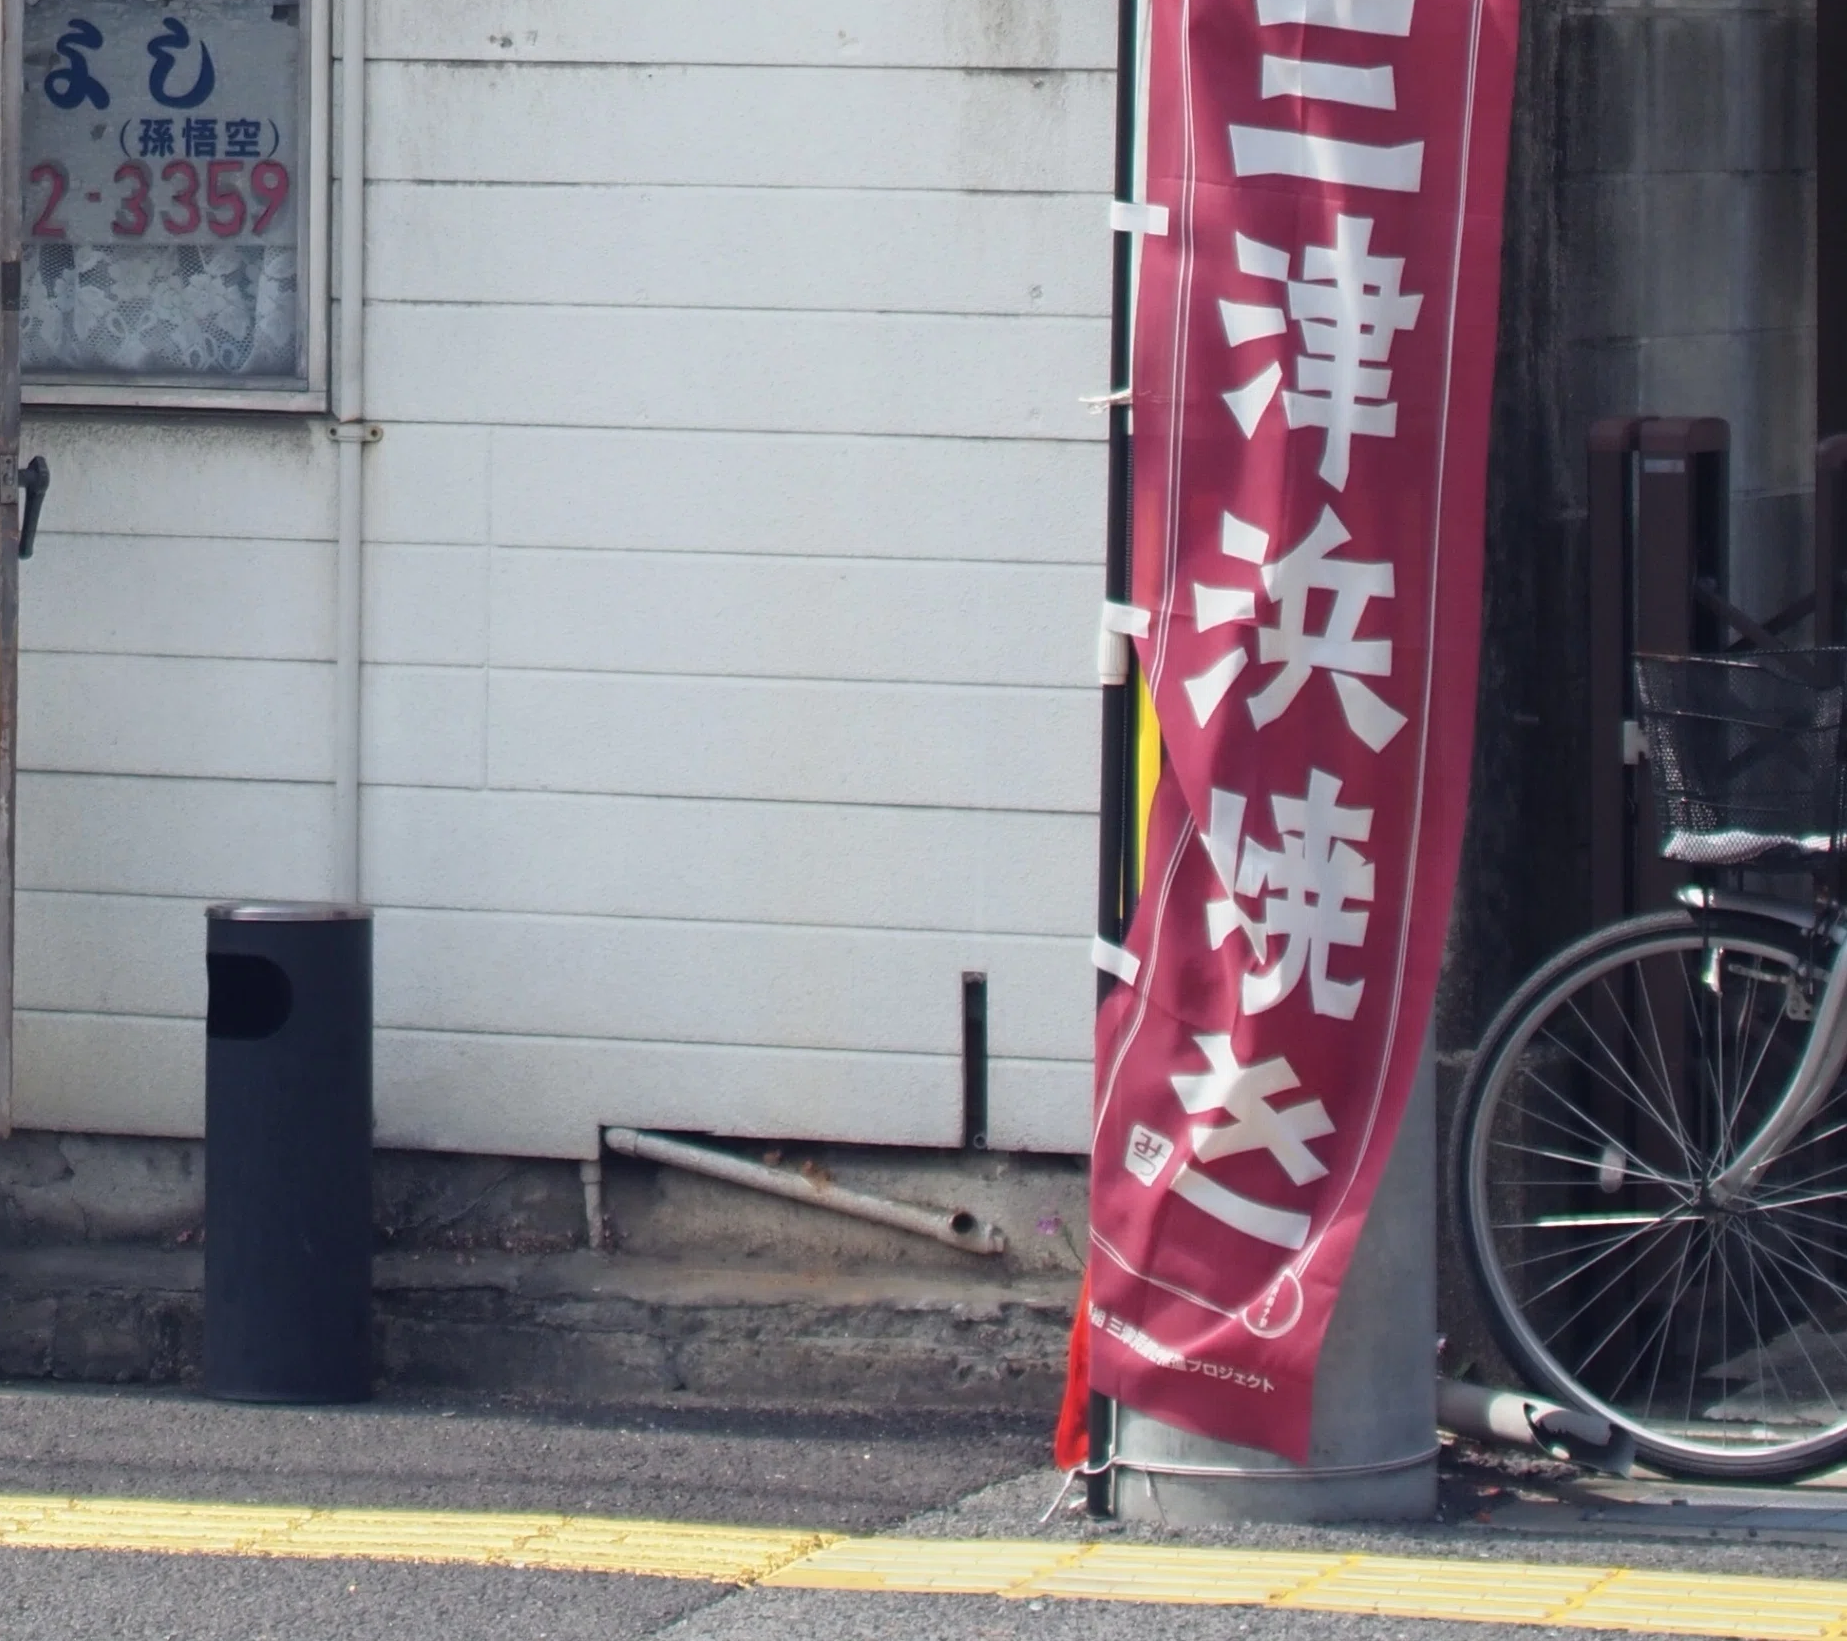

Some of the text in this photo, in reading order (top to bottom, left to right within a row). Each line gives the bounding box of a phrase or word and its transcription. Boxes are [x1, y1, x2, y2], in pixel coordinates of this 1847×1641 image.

[119, 118, 280, 159] (孫悟空)
[29, 159, 290, 238] 2-3359
